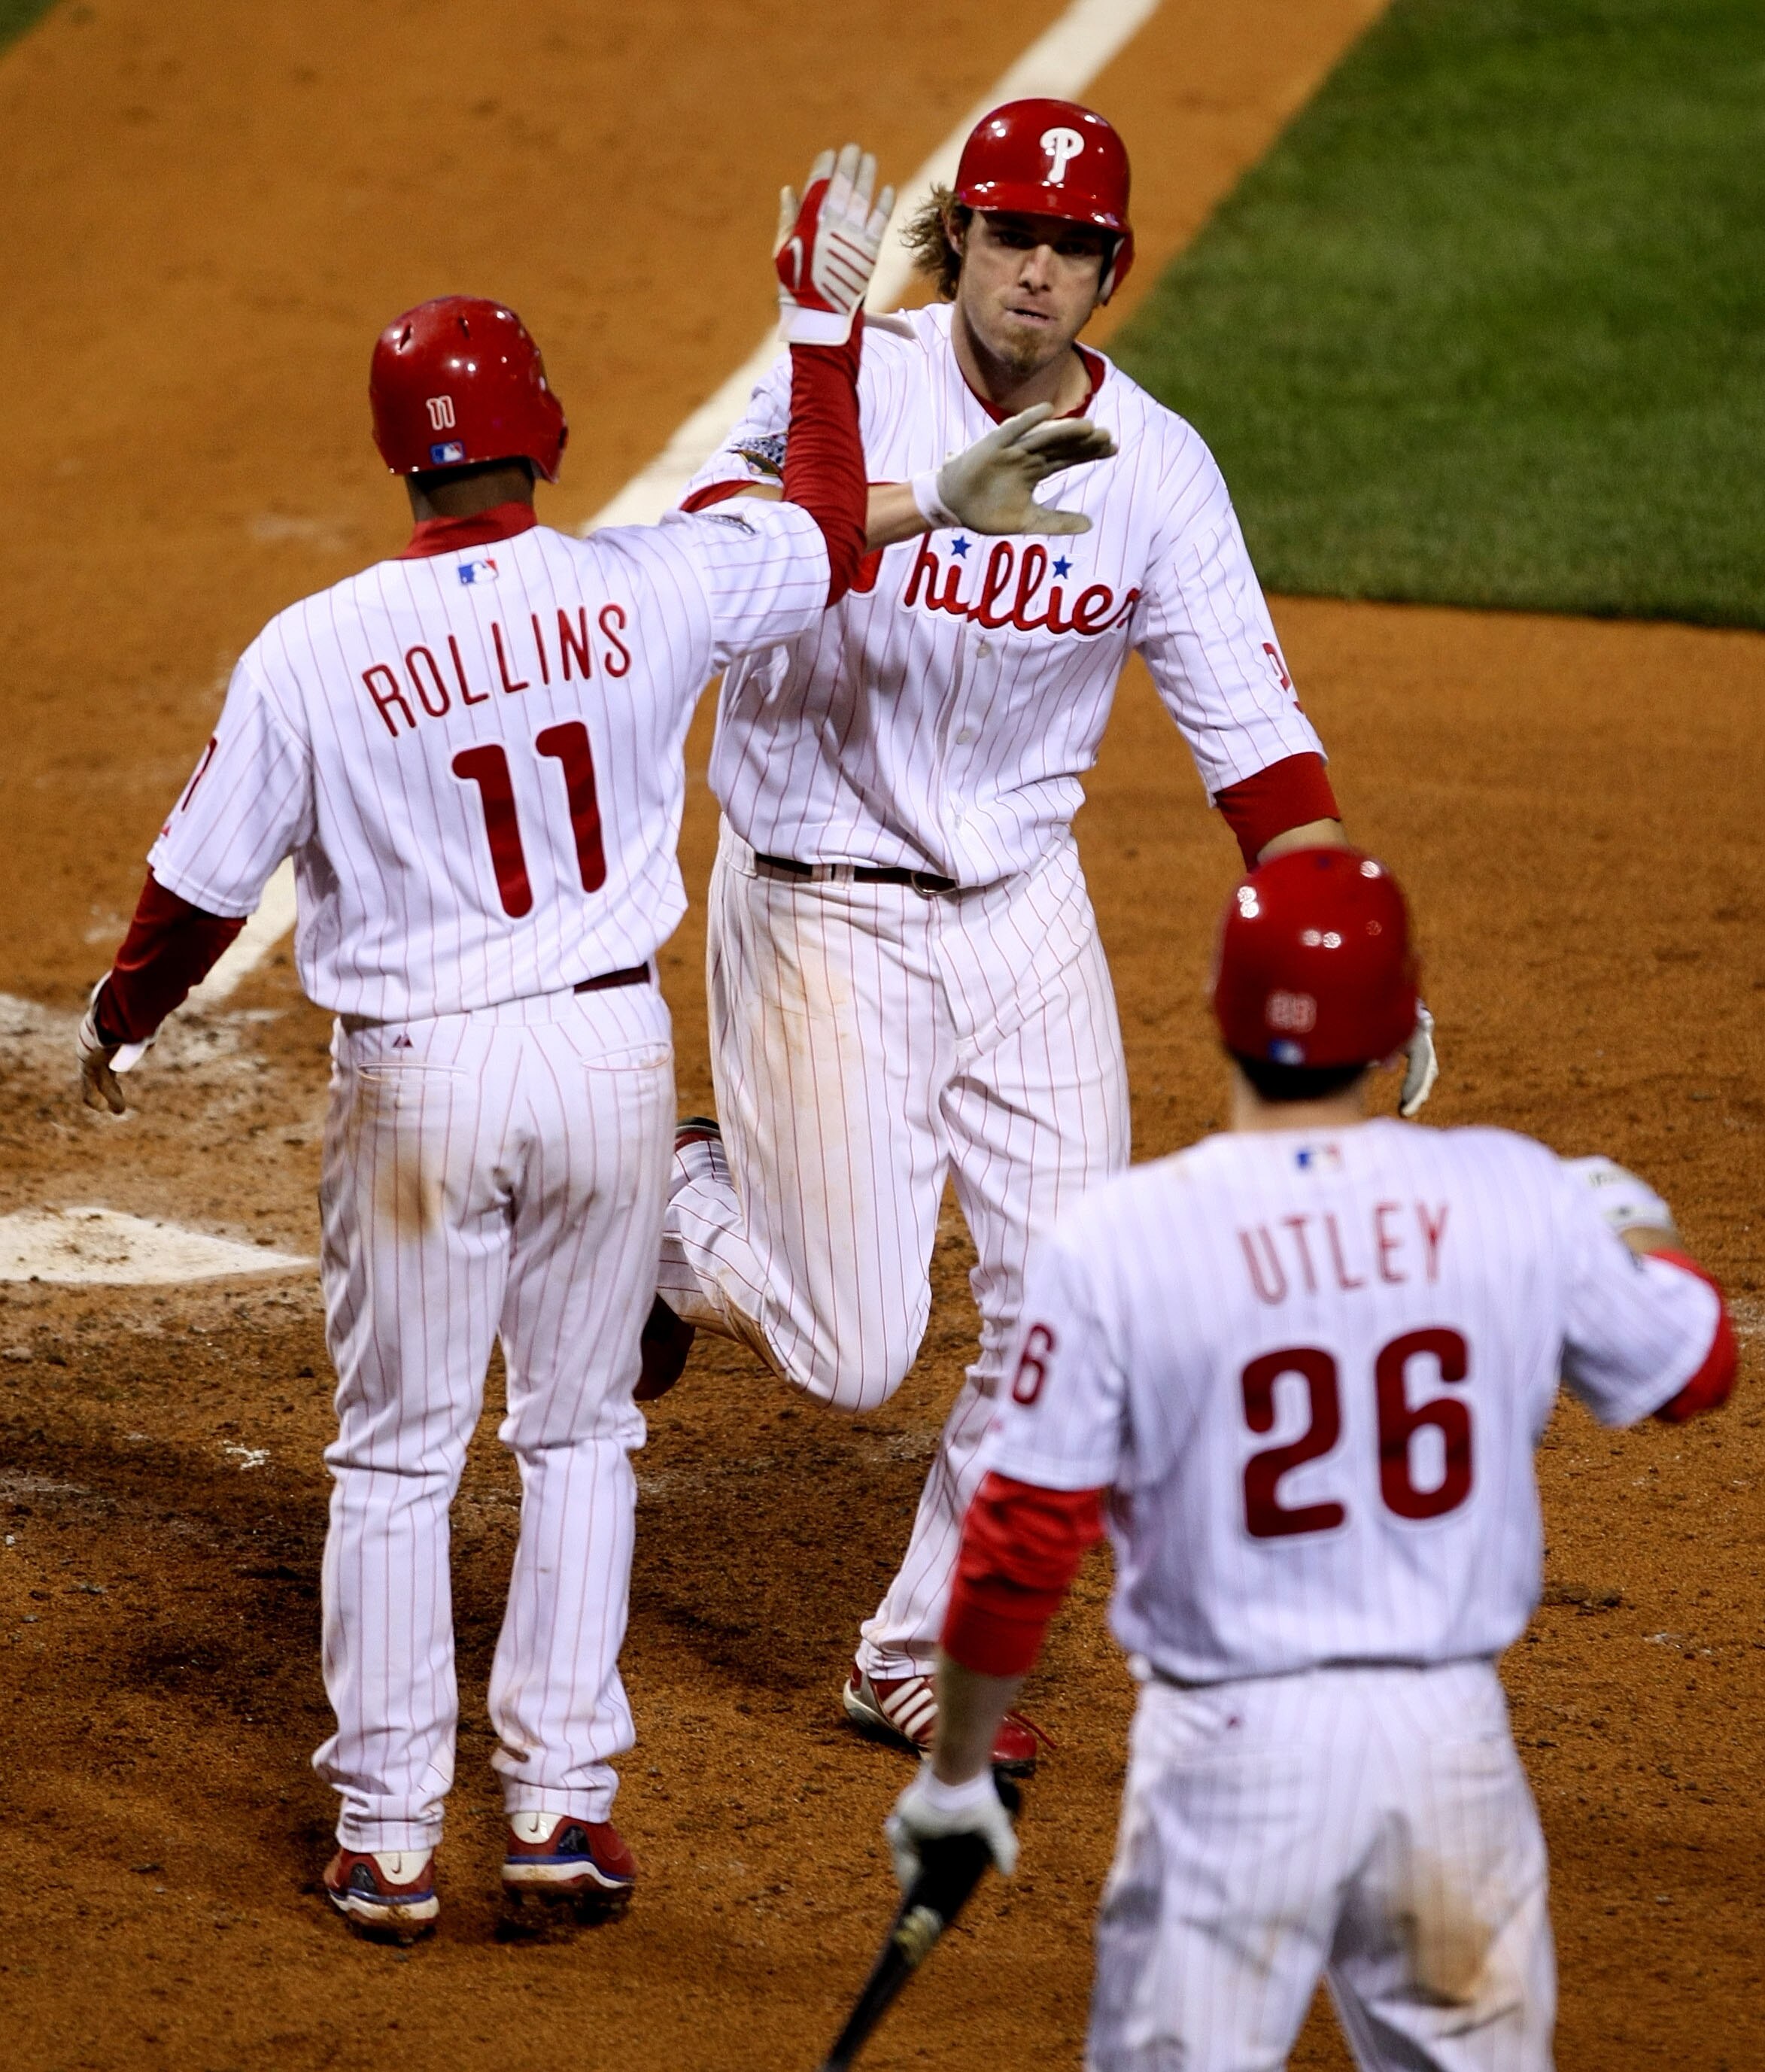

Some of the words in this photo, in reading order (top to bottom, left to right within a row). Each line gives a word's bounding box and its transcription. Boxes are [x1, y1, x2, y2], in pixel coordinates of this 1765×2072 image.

[426, 395, 456, 430] 11
[362, 603, 632, 737] ROLLINS
[451, 721, 607, 919] 11
[1238, 1199, 1450, 1306] UTLEY
[1013, 1323, 1057, 1406] 6
[1241, 1327, 1475, 1539] 26
